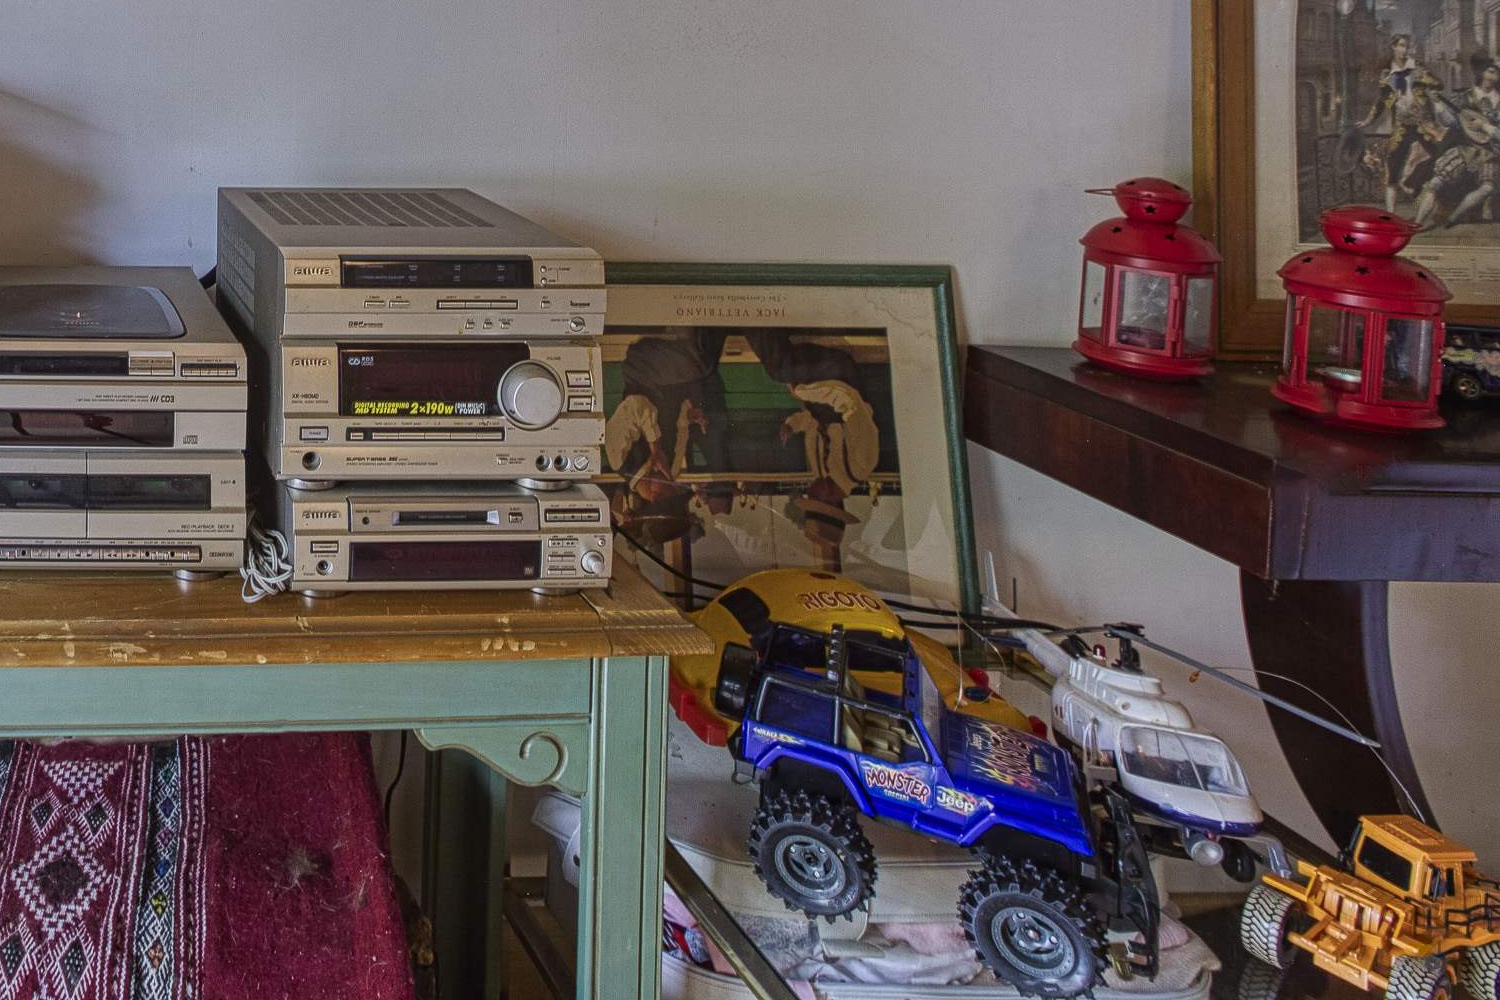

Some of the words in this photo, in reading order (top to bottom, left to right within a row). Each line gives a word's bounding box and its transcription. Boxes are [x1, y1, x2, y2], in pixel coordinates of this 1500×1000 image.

[294, 266, 333, 276] aiwa
[675, 307, 750, 318] VETTRIANO
[755, 307, 787, 318] JACK
[291, 357, 331, 367] aiwa
[160, 394, 175, 403] CD3
[354, 401, 376, 409] DIGITAL
[301, 510, 341, 519] aiwa
[862, 766, 932, 805] MONSTER
[937, 789, 975, 815] Jeep
